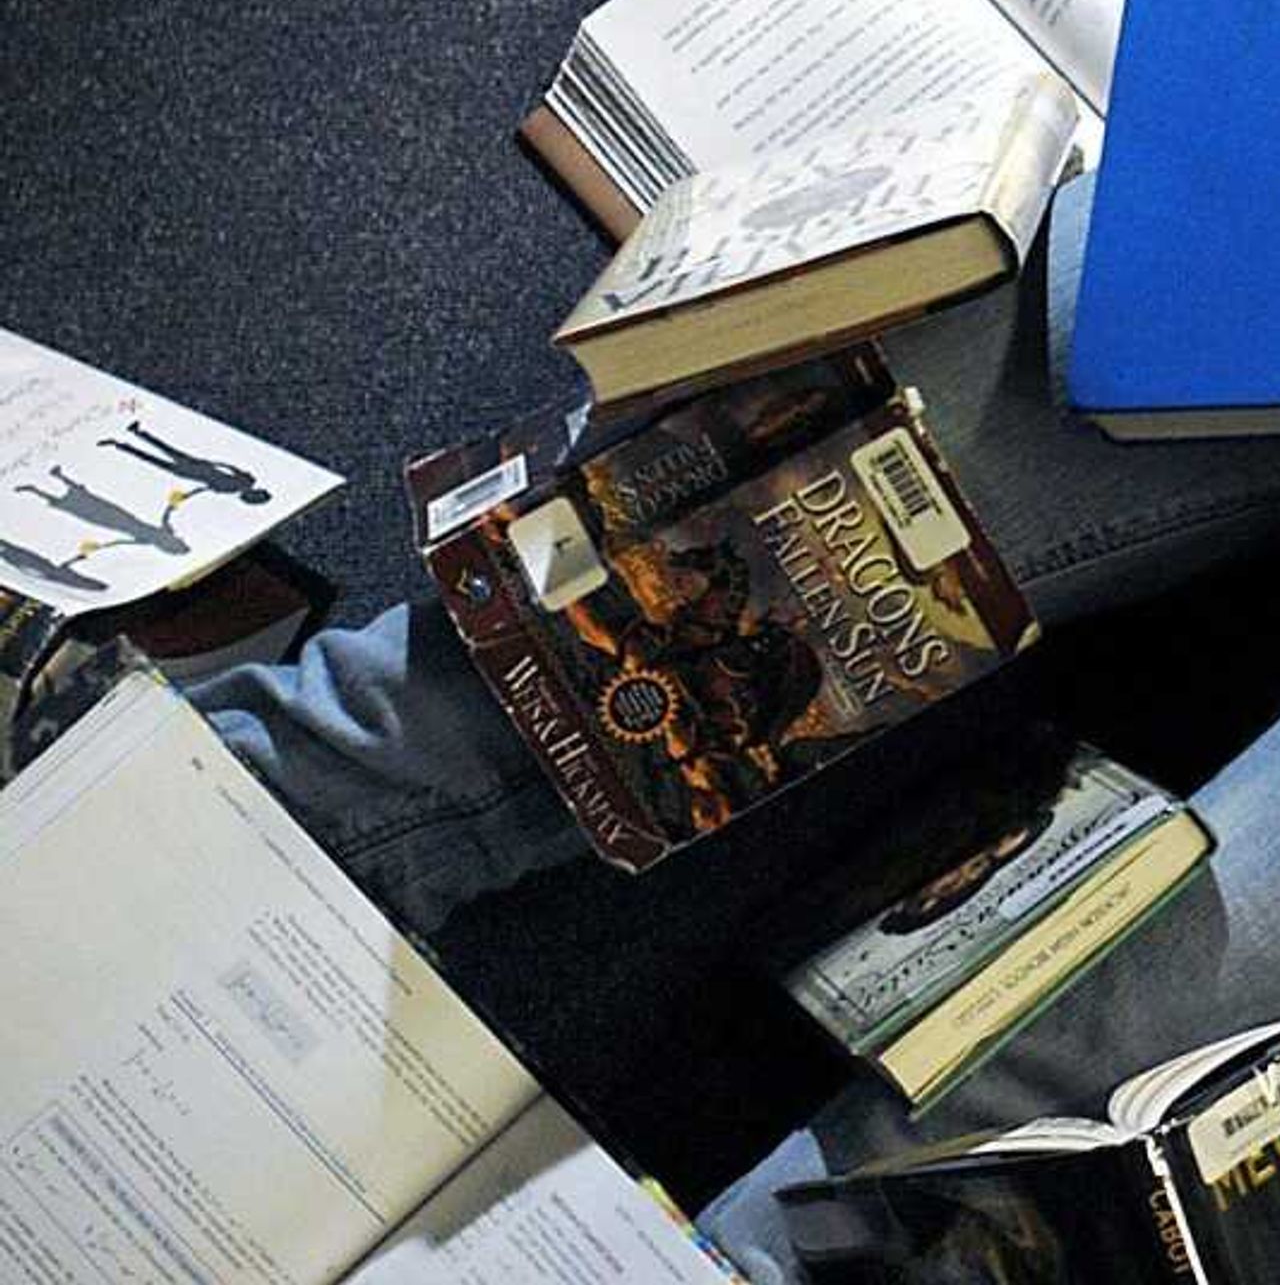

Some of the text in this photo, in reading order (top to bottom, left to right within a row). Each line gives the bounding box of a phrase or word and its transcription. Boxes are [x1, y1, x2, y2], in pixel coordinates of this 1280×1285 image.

[752, 495, 852, 639] FALLEN
[829, 617, 894, 707] SUN
[796, 468, 953, 682] DRAGONS
